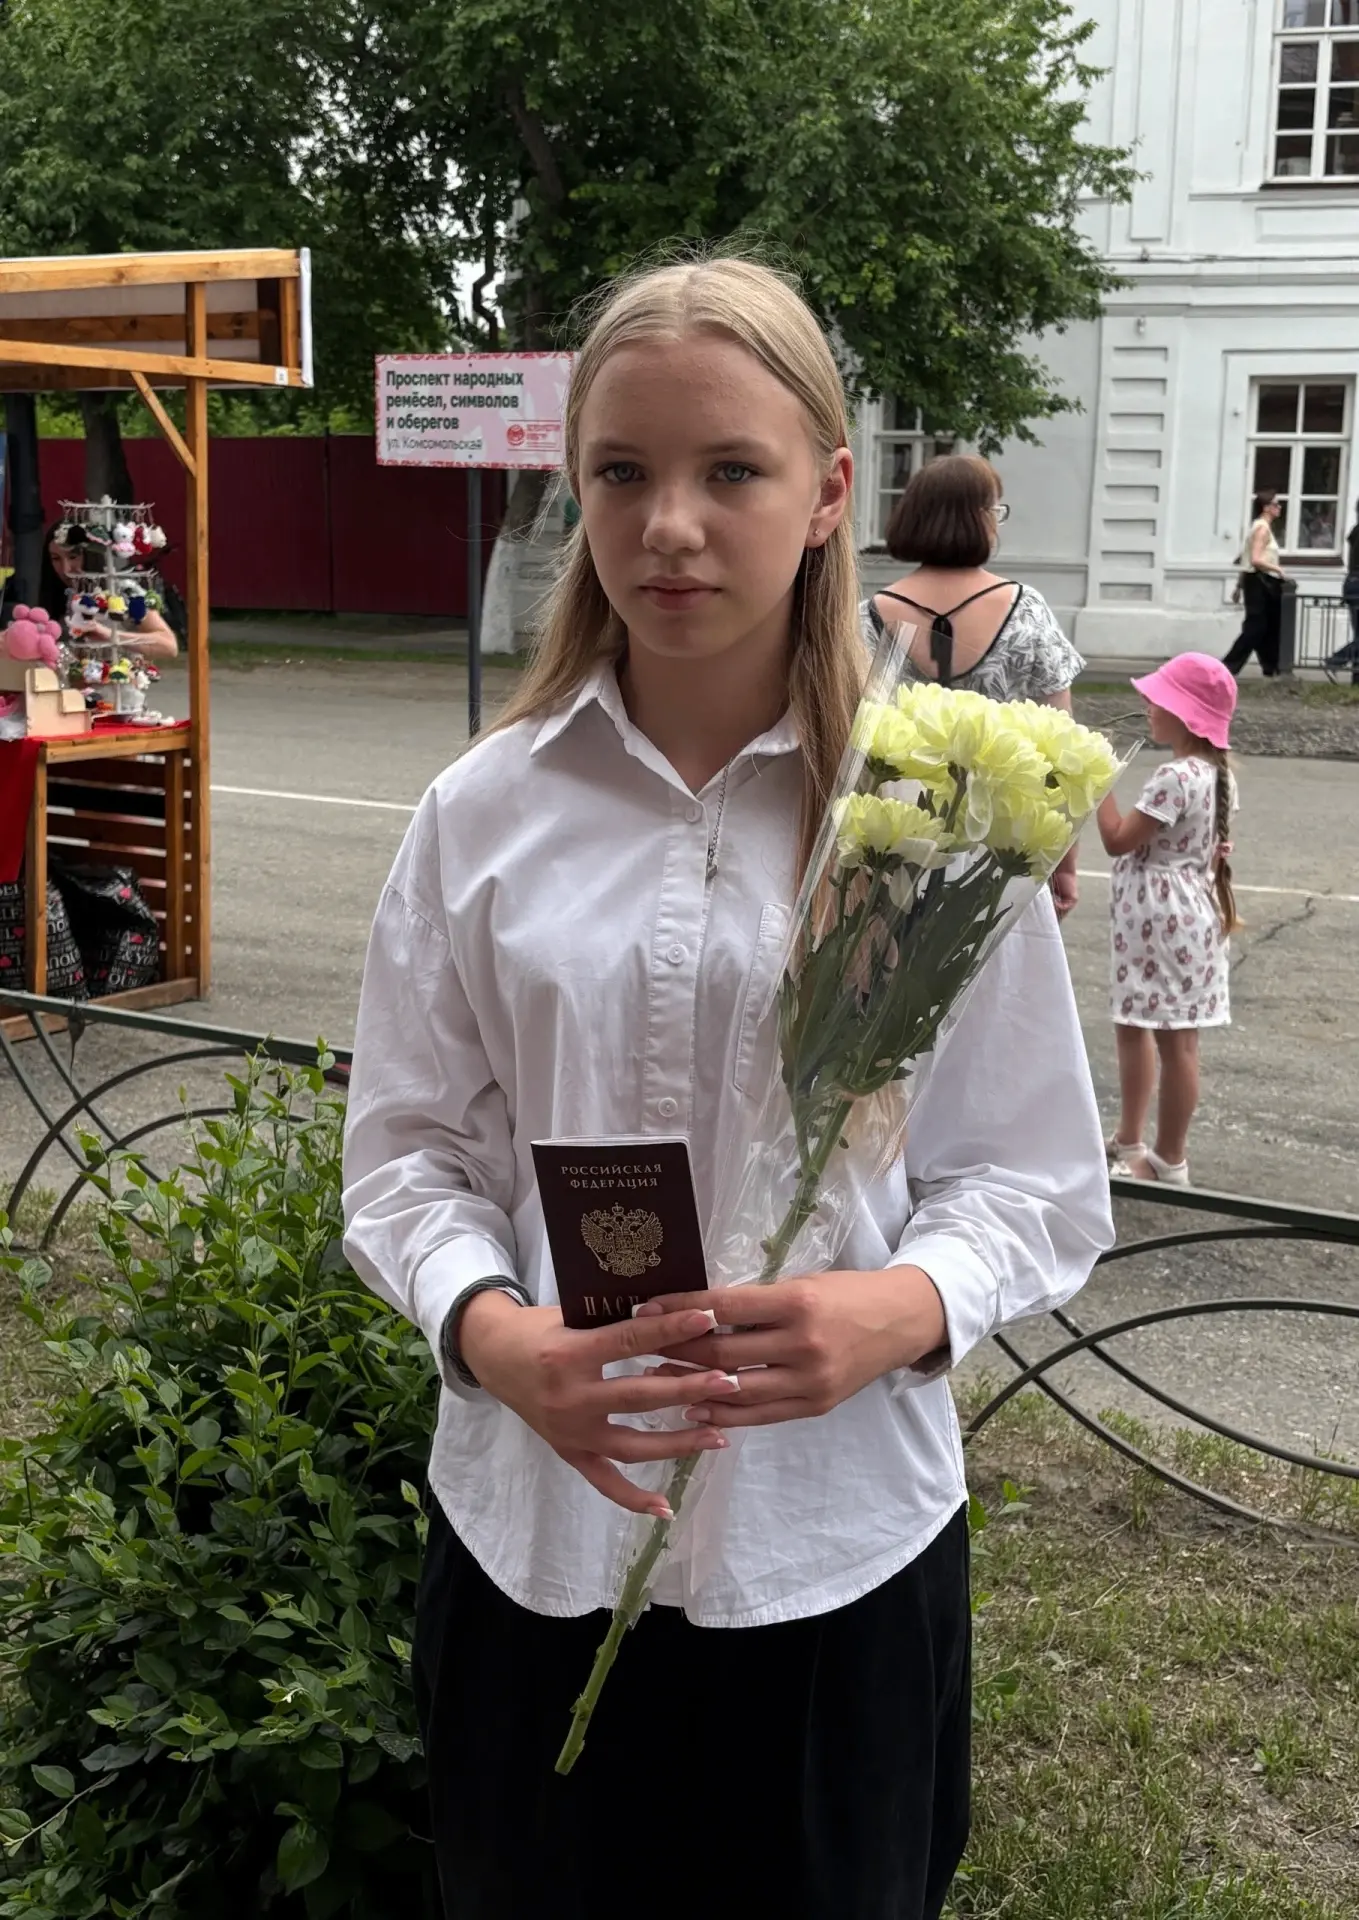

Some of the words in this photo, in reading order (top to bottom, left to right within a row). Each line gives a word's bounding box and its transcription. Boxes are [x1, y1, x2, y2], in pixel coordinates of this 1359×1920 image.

[386, 371, 450, 389] Проспект
[453, 372, 524, 389] народных
[386, 392, 446, 410] ремёсел,
[451, 395, 519, 408] символов
[386, 417, 394, 428] и
[397, 414, 459, 433] оберегов
[387, 439, 400, 451] ул.
[403, 438, 482, 450] Комсомольская
[561, 1164, 662, 1175] РОССИЙСКАЯ
[570, 1178, 658, 1189] ФЕДЕРАЦИЯ
